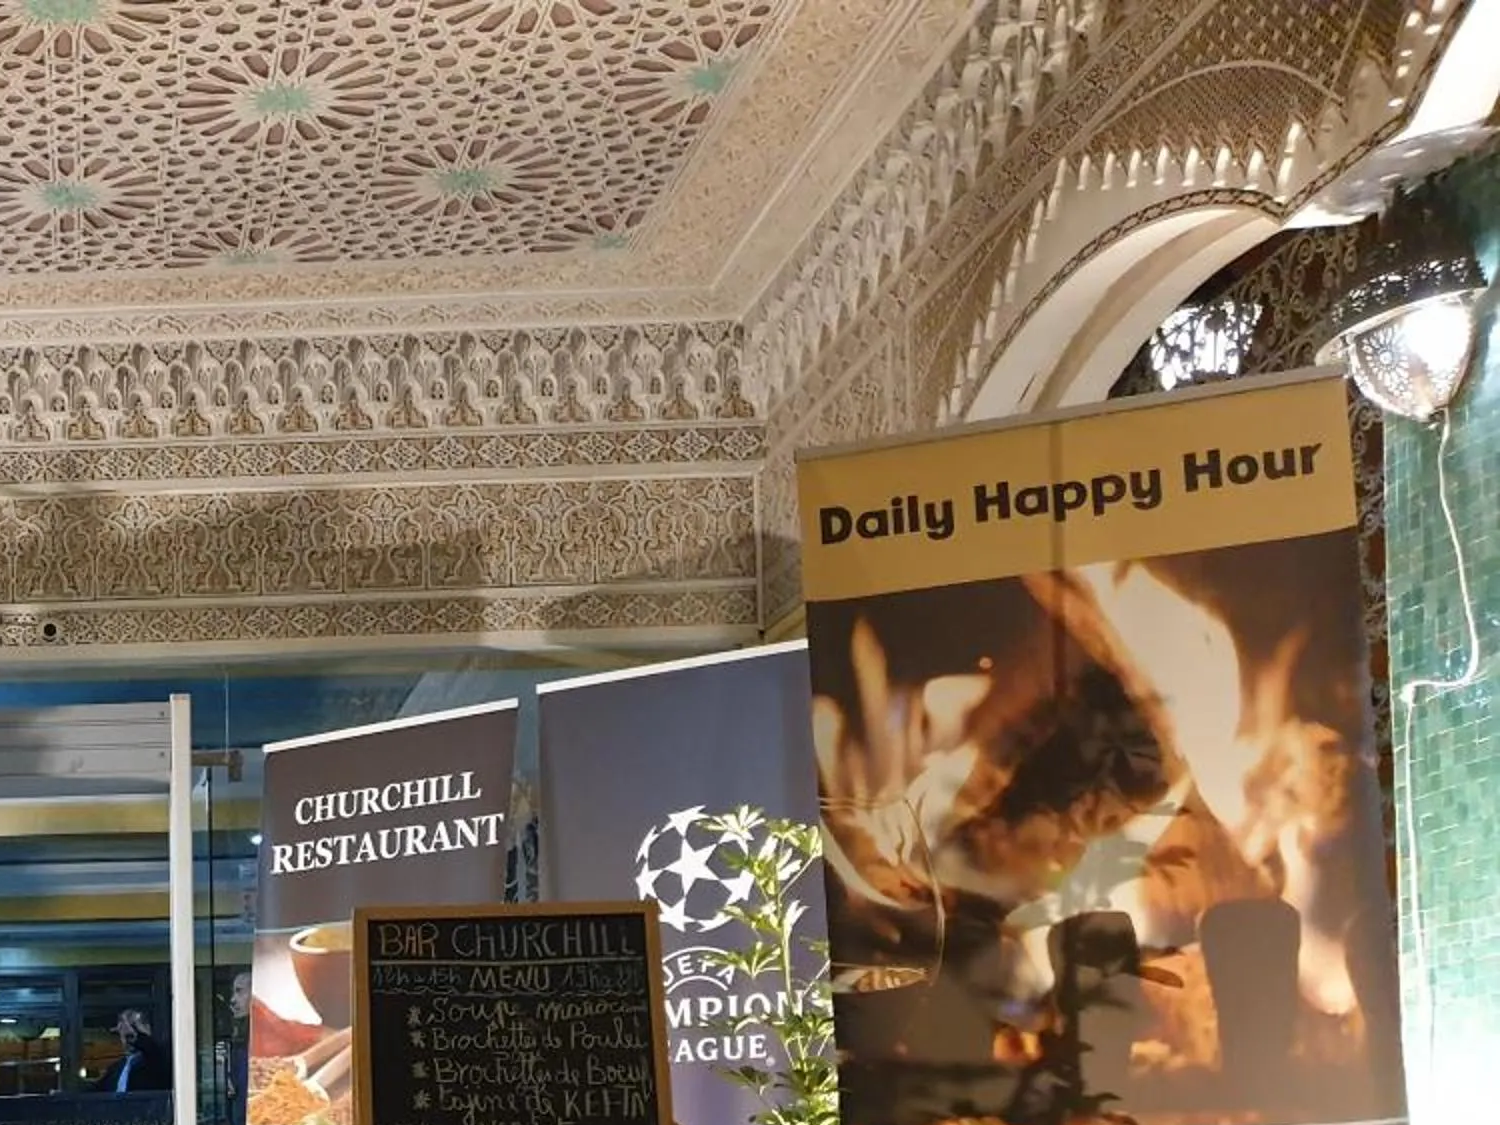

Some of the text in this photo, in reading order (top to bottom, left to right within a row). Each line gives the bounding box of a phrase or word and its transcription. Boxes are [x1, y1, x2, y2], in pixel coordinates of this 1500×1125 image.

[819, 443, 1323, 544] Daily Happy Hour
[294, 771, 483, 826] CHURCHILL
[270, 812, 505, 875] RESTAURANT
[379, 923, 439, 957] BAR
[469, 966, 551, 990] MENU
[665, 991, 805, 1029] MPION
[667, 1033, 767, 1063] AGUE
